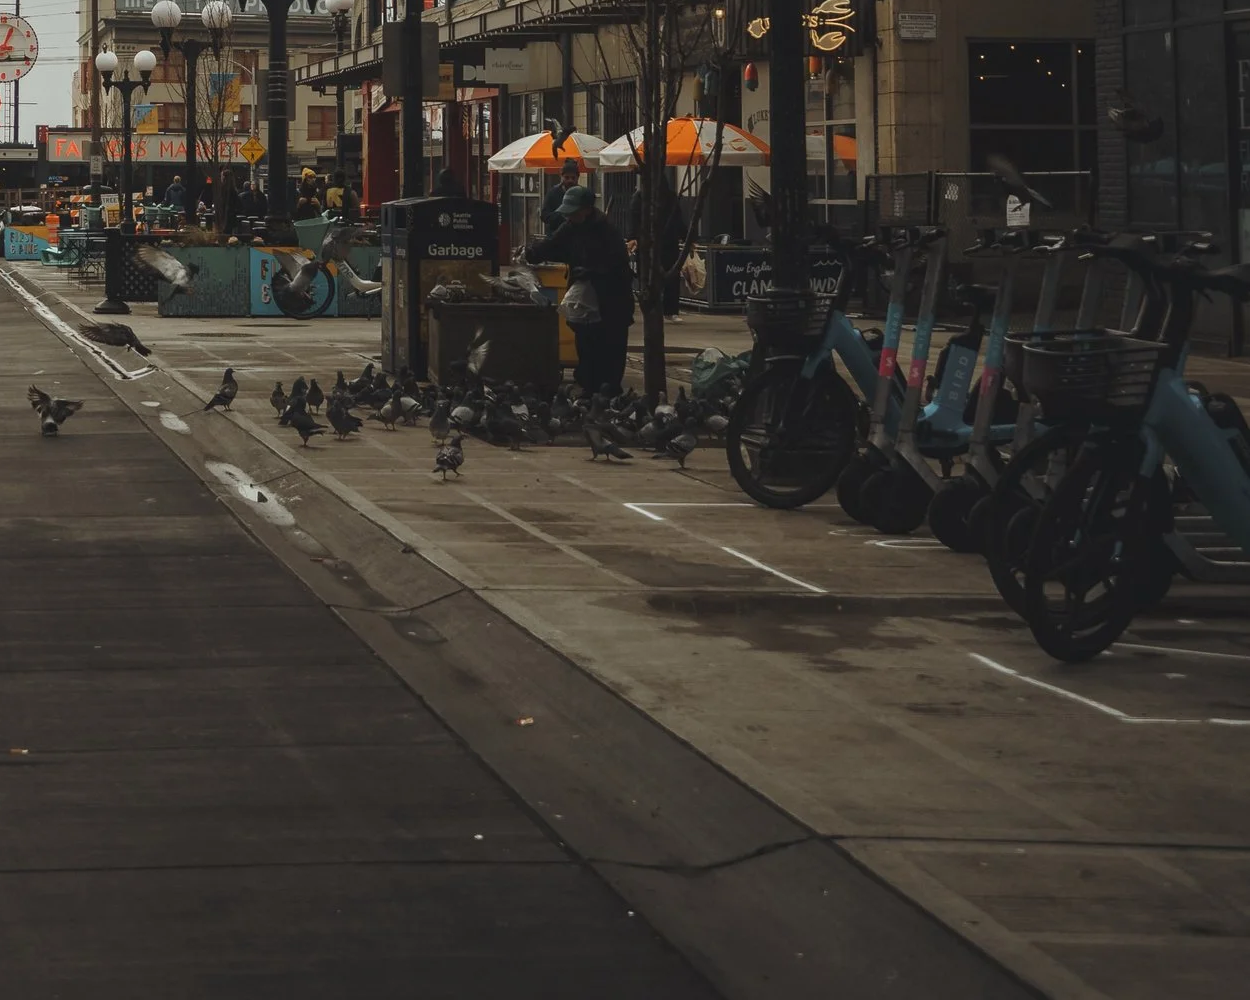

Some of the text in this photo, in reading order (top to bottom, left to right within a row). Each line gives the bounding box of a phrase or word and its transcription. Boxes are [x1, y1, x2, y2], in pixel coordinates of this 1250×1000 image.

[428, 243, 483, 258] Garbage
[726, 261, 772, 277] New Engla
[732, 279, 773, 296] CLAM
[949, 355, 968, 401] BIRD
